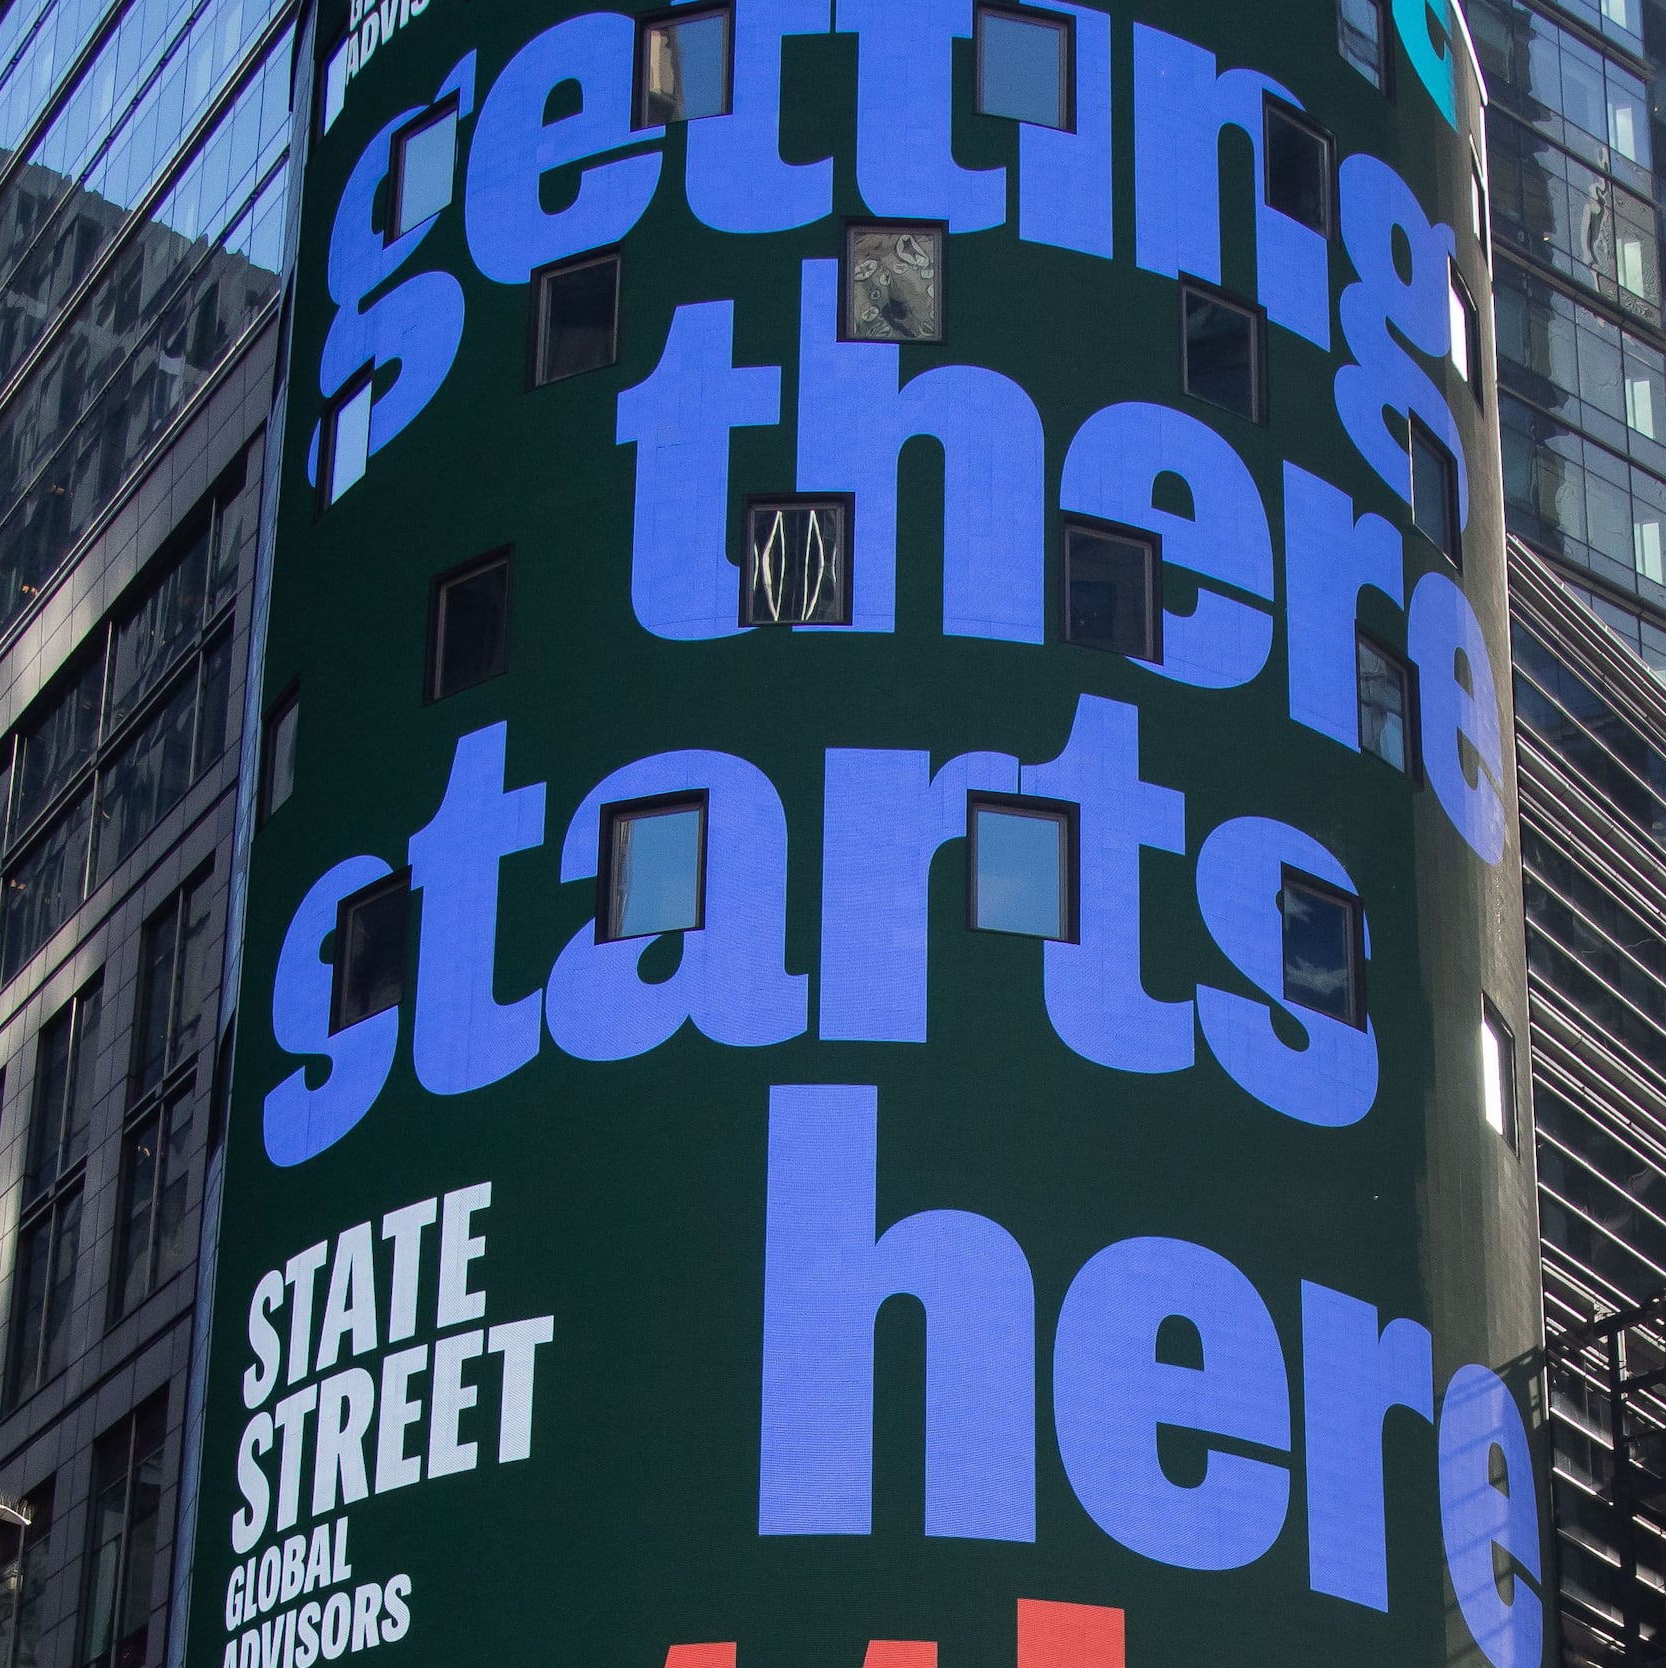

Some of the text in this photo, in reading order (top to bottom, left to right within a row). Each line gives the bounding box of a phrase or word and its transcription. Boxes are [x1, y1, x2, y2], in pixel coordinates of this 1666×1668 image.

[307, 0, 1469, 532] getting
[616, 258, 1505, 865] there
[263, 693, 1380, 1168] starts
[231, 1315, 555, 1555] STREET
[244, 1182, 492, 1409] STATE
[225, 1516, 352, 1631] GLOBAL
